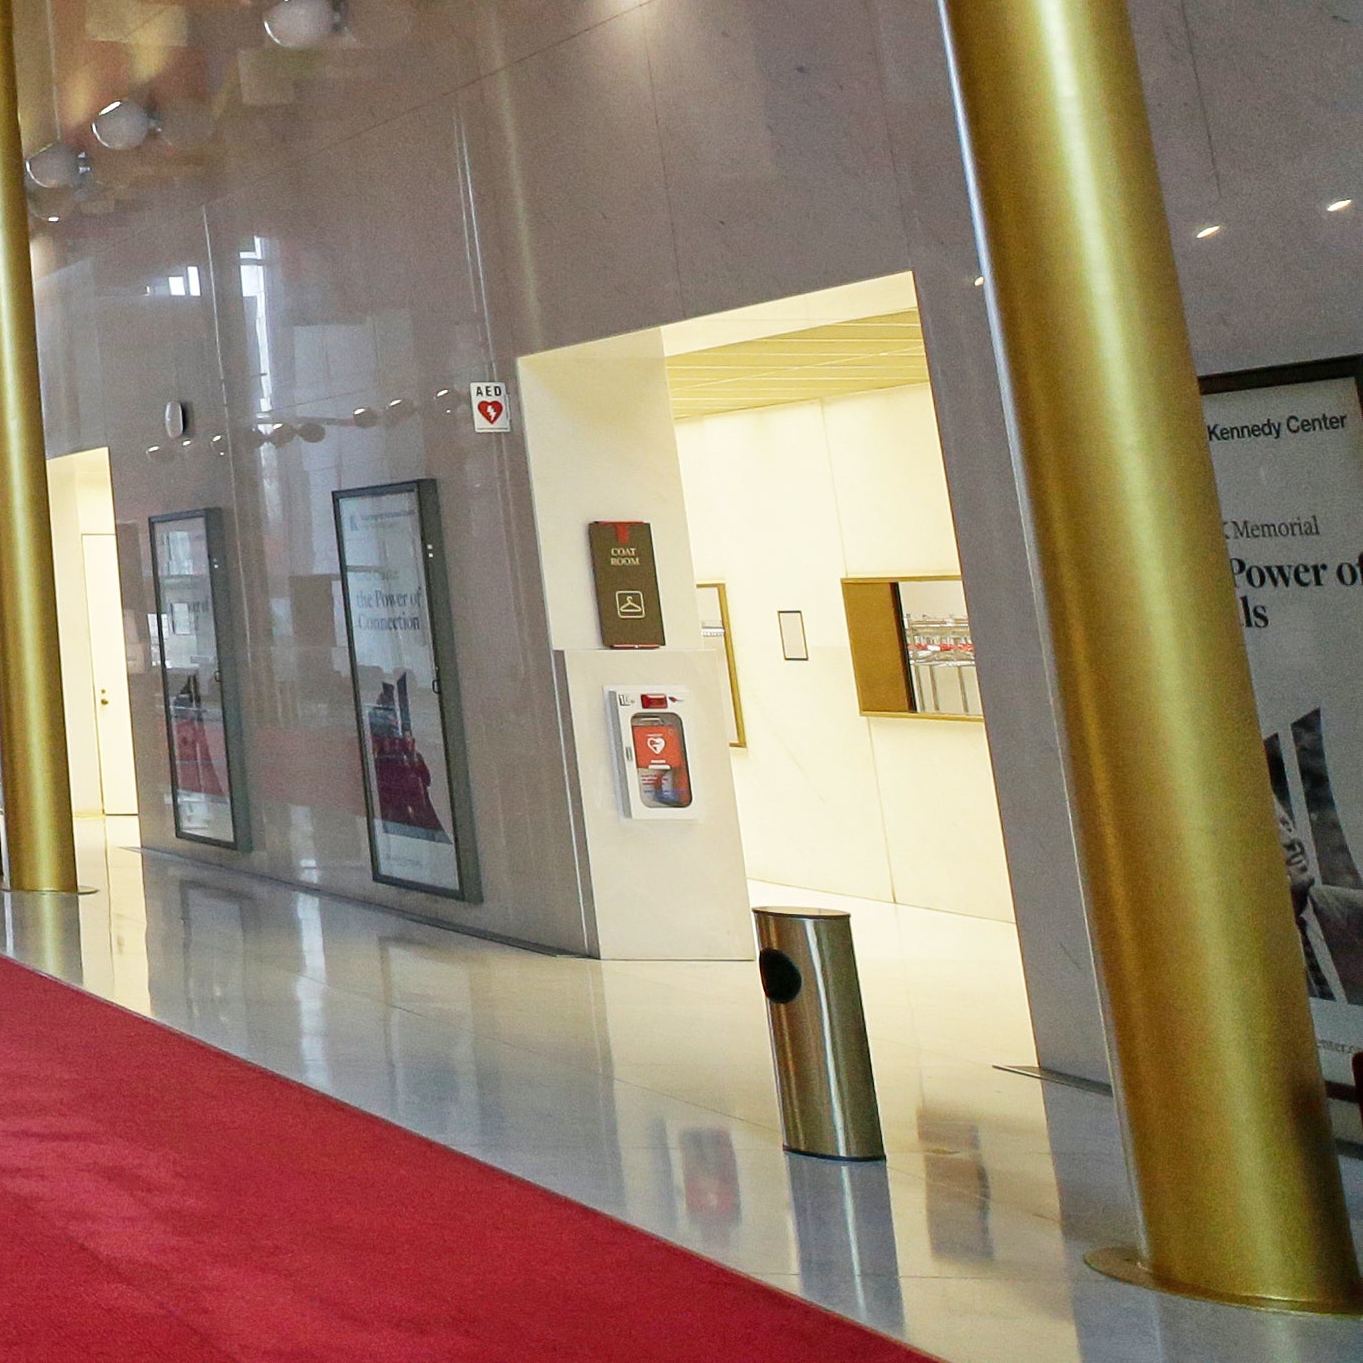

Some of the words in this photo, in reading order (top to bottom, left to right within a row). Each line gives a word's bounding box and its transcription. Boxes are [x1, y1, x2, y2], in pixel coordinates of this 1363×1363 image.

[476, 386, 502, 396] AED
[1207, 418, 1282, 441] Kennedy
[1286, 412, 1347, 434] Center
[1231, 515, 1320, 540] Memorial
[610, 557, 640, 566] ROOM
[611, 548, 636, 556] COAT
[1229, 556, 1328, 588] Power
[375, 589, 408, 608] Power
